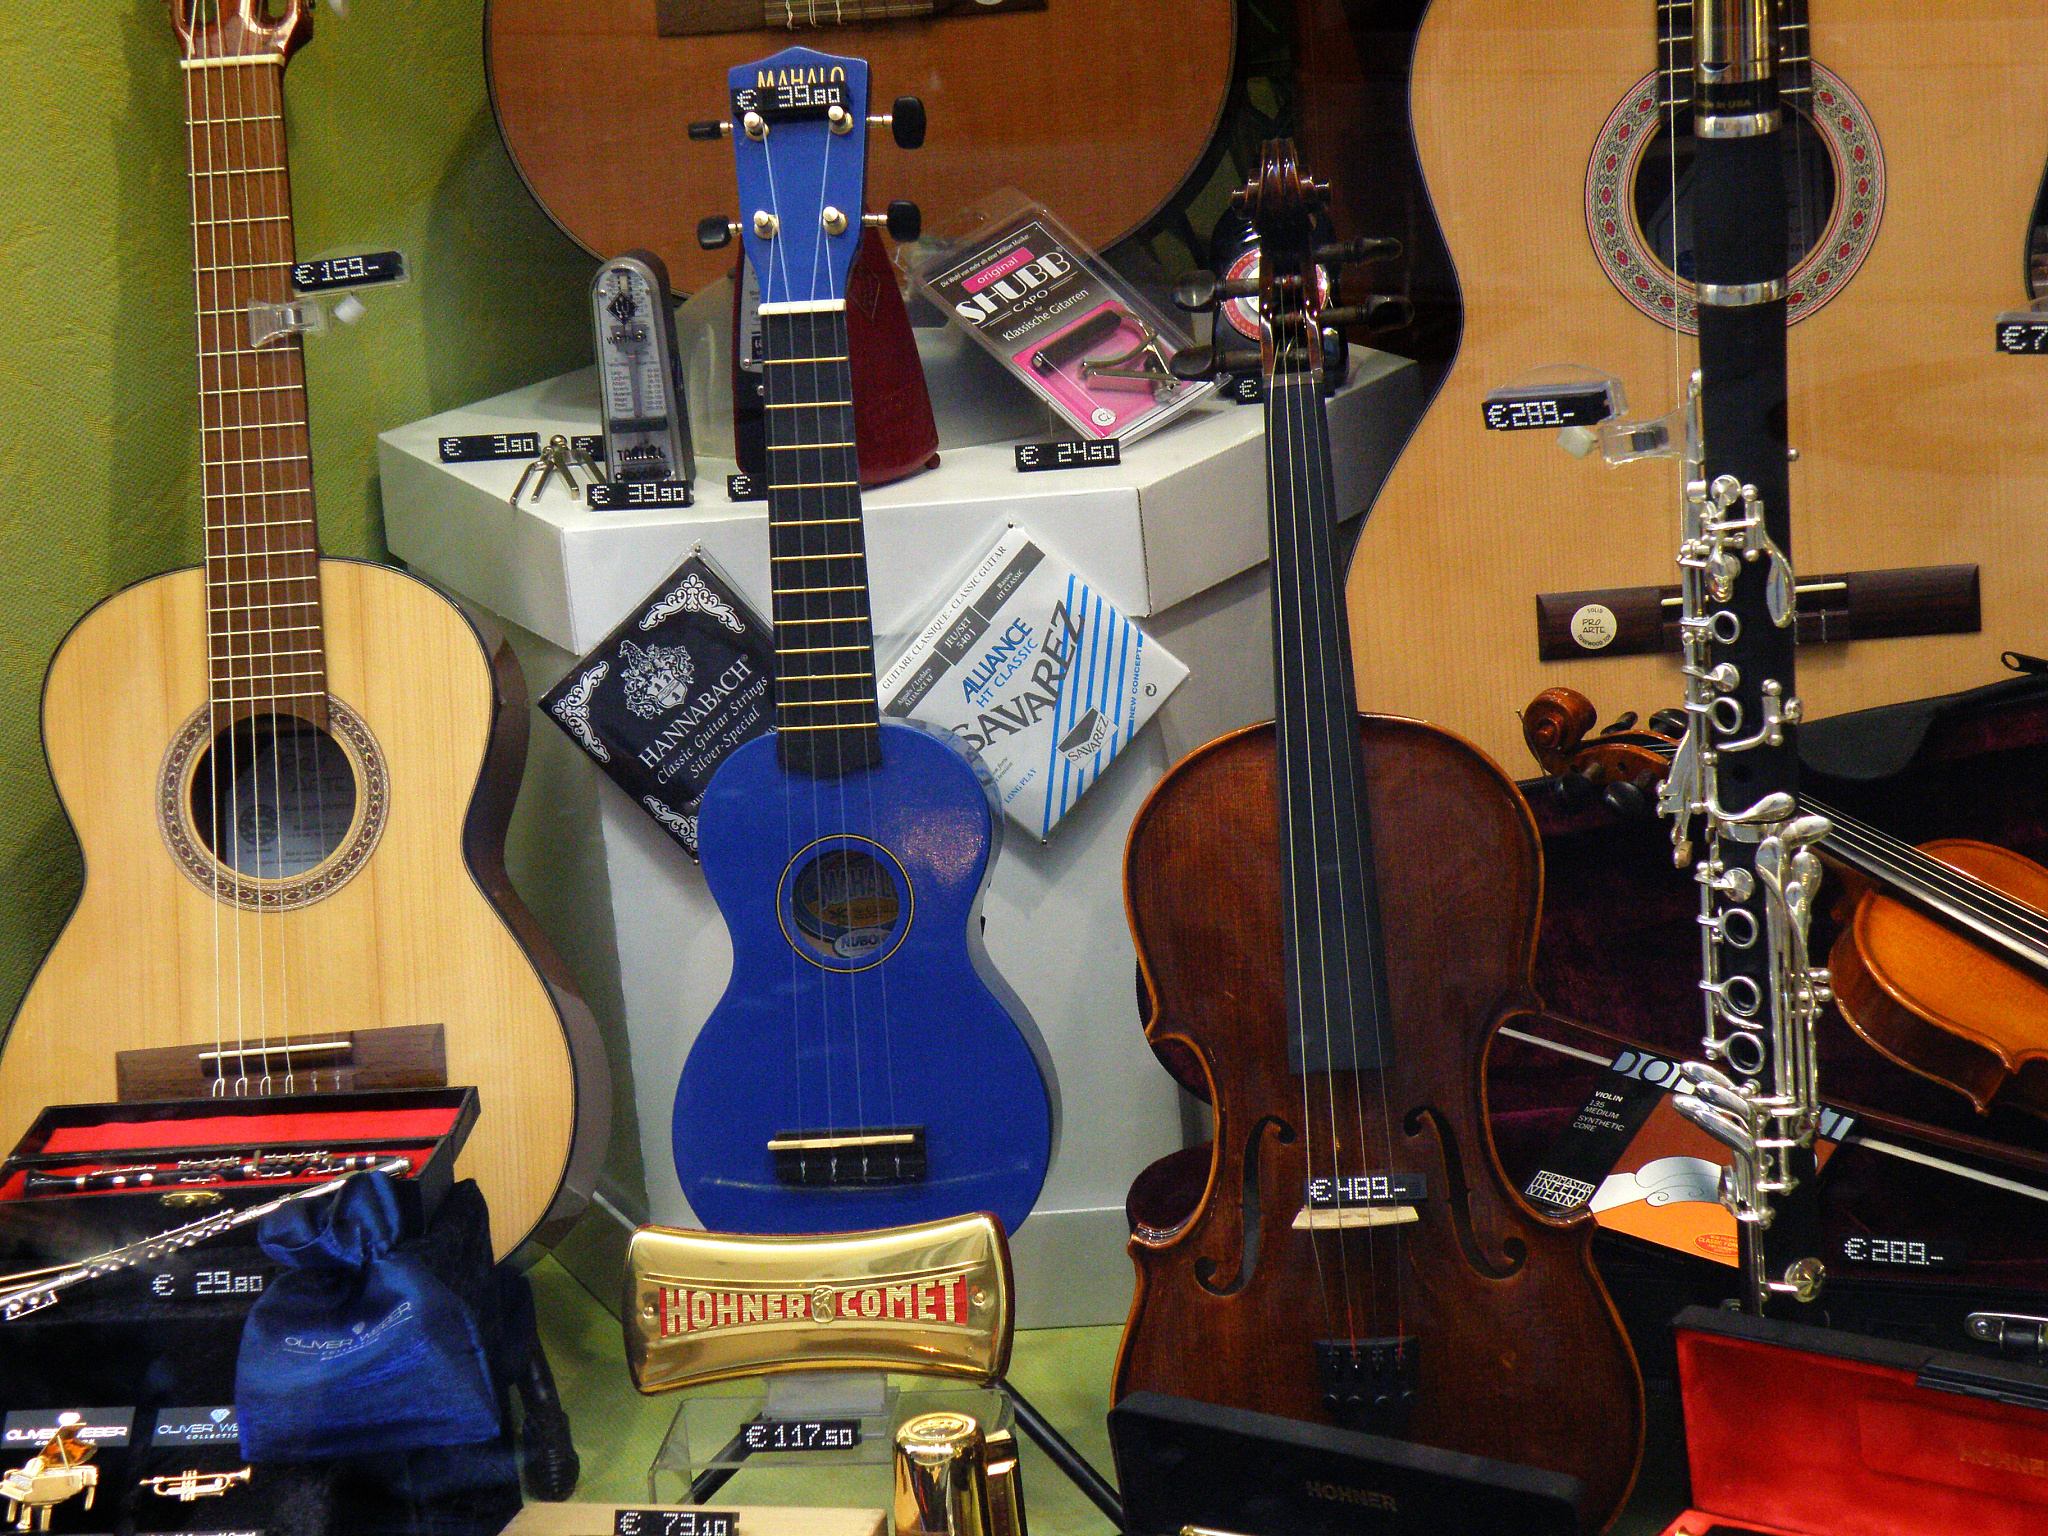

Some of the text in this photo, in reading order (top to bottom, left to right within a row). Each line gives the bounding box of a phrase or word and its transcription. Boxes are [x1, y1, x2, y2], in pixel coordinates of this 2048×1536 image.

[778, 85, 840, 108] 39.80
[977, 256, 1019, 284] original
[955, 252, 1071, 325] SHUBB
[1012, 289, 1049, 313] CAPO
[1002, 288, 1090, 341] Klassische Gitarren
[494, 435, 535, 453] 3.90
[1058, 442, 1114, 462] 24.50
[629, 483, 684, 502] 39.90
[1003, 568, 1025, 594] CLASSIC
[882, 655, 914, 690] GUITARE
[912, 612, 949, 655] CLASSIQUE
[951, 575, 980, 610] CLASSIC
[978, 545, 1007, 578] GUITAR
[1582, 618, 1602, 626] PRO
[944, 617, 972, 649] JEU/SET
[1582, 626, 1607, 634] ARTE
[956, 634, 970, 650] 540
[963, 617, 1034, 704] ALLIANCE
[950, 599, 1085, 752] SAVAREZ
[976, 638, 1039, 708] HT CLASSIC
[1129, 645, 1143, 721] NEW CONCEPT
[638, 659, 752, 770] HANNABACH
[657, 676, 769, 784] Classic Guitar Strings
[690, 704, 761, 779] Silver-Special
[1067, 716, 1109, 762] SAVAREZ
[1003, 784, 1023, 804] LONG
[1589, 1099, 1605, 1109] 135
[1595, 1090, 1624, 1103] VIOLIN
[1577, 1115, 1625, 1132] SYNTHETIC
[1584, 1106, 1620, 1120] MEDIUM
[1572, 1121, 1597, 1133] CORE
[1531, 1178, 1589, 1201] INFELD
[1537, 1171, 1593, 1193] THOMASTIK
[196, 1268, 263, 1295] 29.80
[665, 1274, 961, 1336] HOHNER COMET
[285, 1337, 353, 1349] OLIVER
[158, 1423, 214, 1434] OLIVER
[1305, 1480, 1398, 1512] HOHNER
[663, 1513, 727, 1536] 73.10
